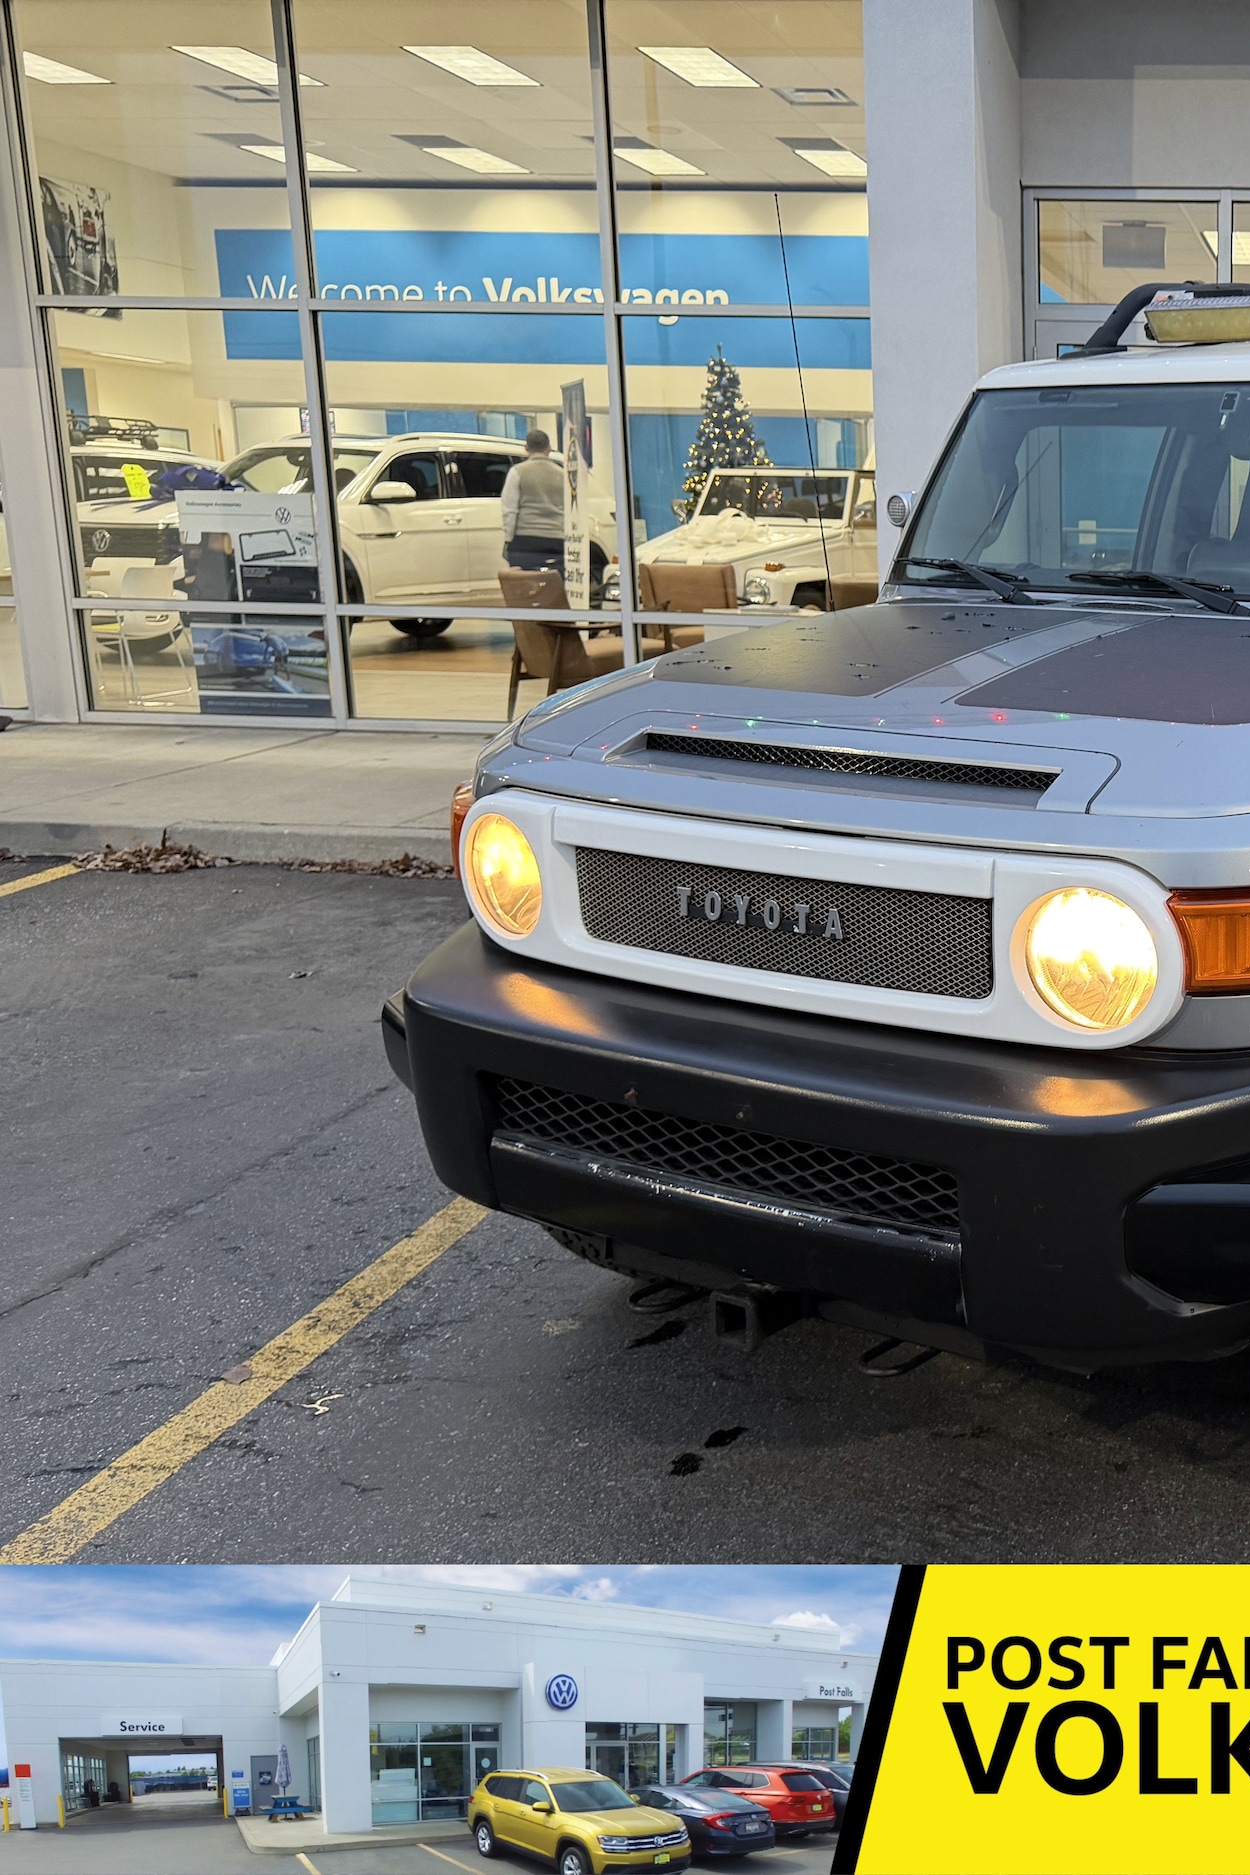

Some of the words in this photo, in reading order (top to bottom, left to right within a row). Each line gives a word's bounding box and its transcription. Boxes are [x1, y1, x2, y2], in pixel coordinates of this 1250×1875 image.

[246, 274, 424, 302] Wecome
[434, 280, 472, 302] to
[677, 886, 843, 940] TOYOTA
[819, 1685, 835, 1697] Post
[836, 1686, 854, 1697] Falls
[119, 1720, 166, 1732] Service
